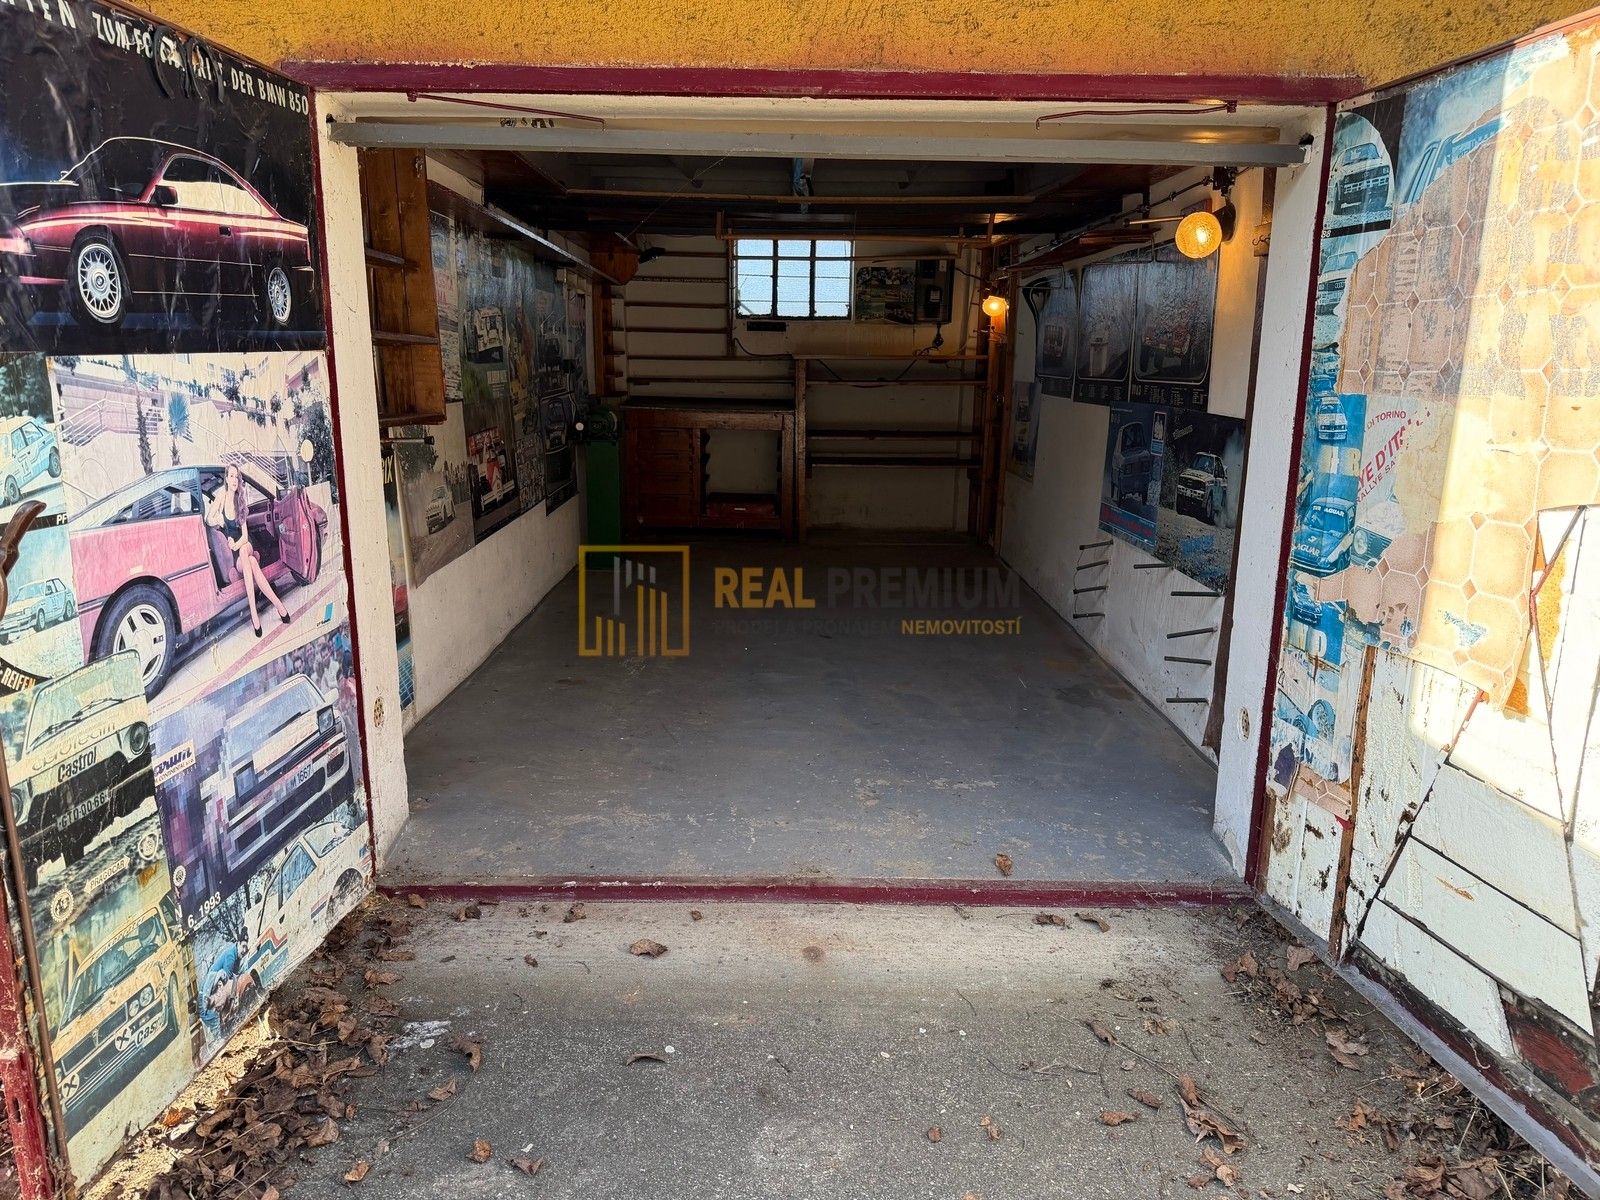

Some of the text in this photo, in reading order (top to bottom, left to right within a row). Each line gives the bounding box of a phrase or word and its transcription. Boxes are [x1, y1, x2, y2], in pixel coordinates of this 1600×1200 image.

[91, 11, 131, 51] ZUM
[231, 69, 255, 97] DER
[258, 78, 286, 108] BMW
[289, 90, 309, 116] 850
[1375, 410, 1407, 421] TORINO
[57, 746, 97, 783] Castrol
[198, 891, 221, 918] 1993
